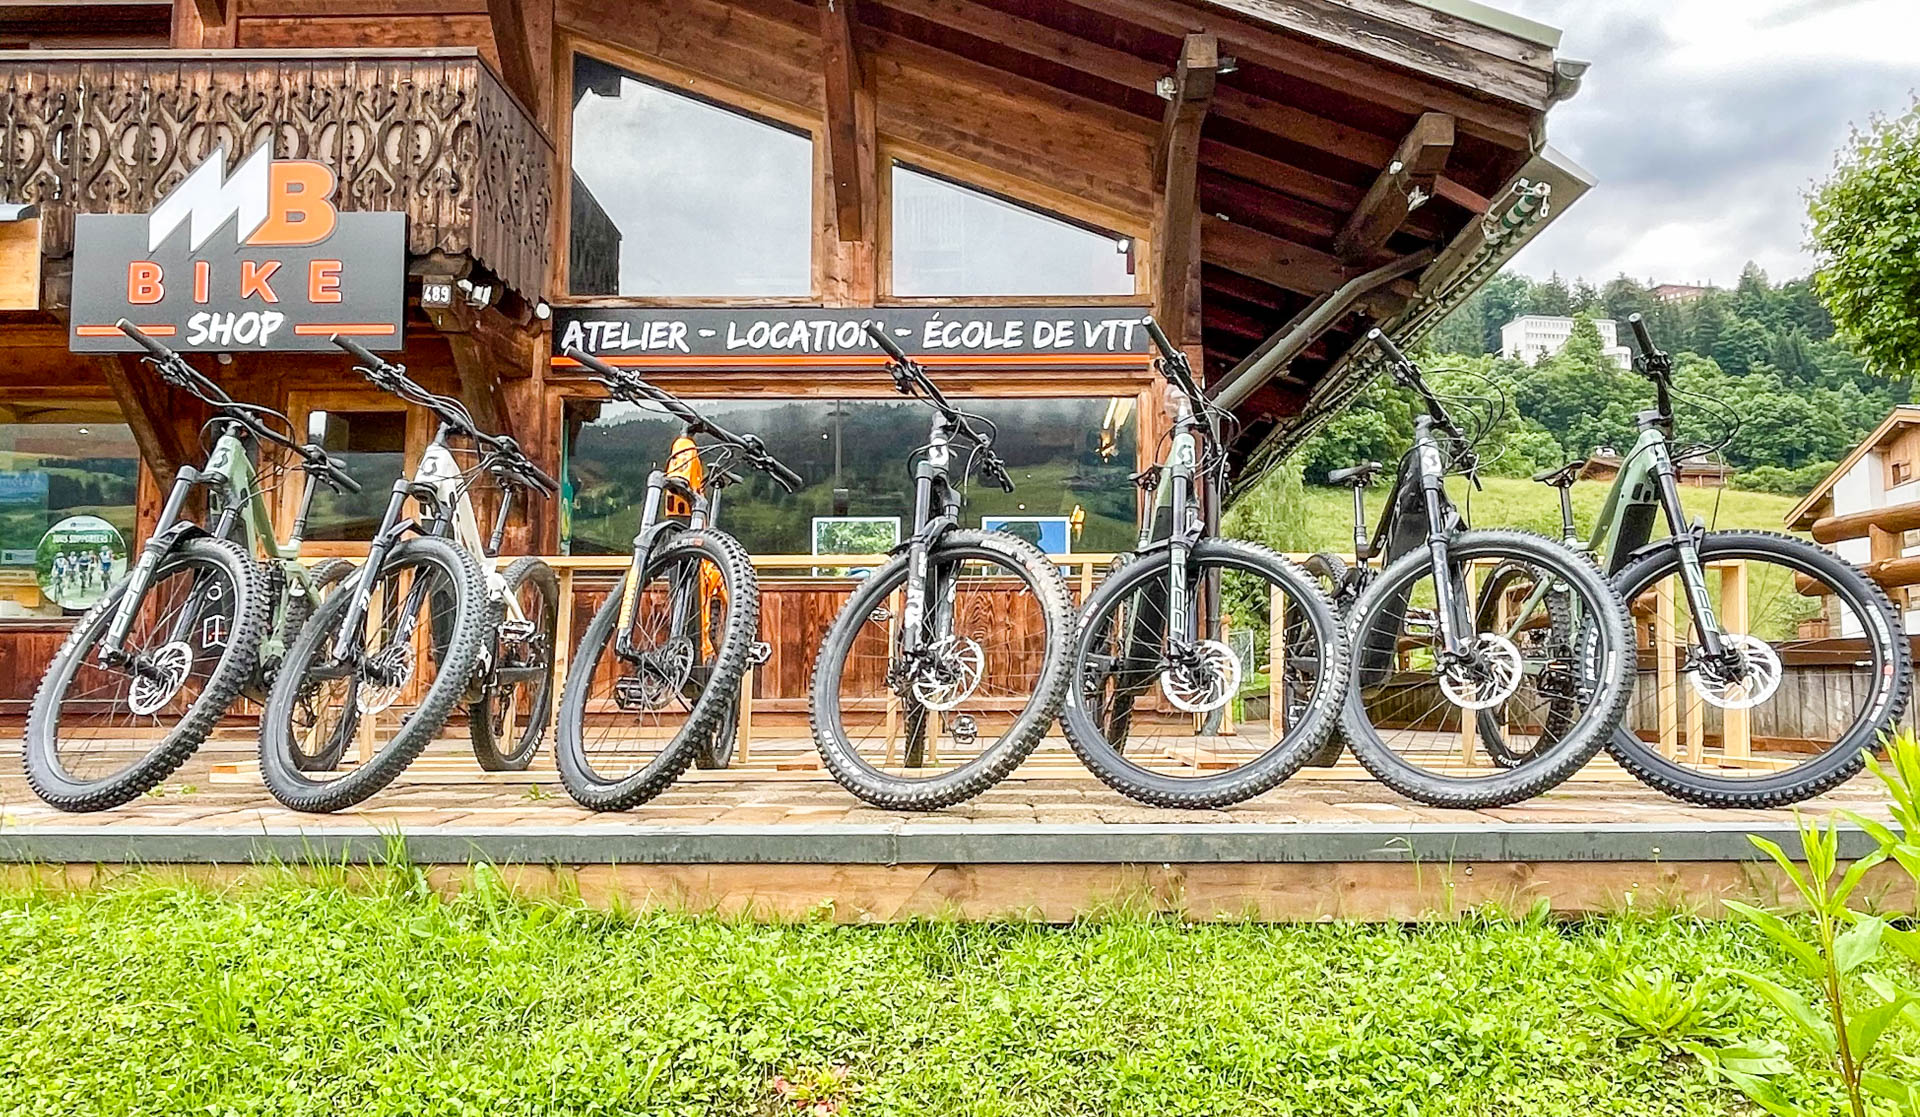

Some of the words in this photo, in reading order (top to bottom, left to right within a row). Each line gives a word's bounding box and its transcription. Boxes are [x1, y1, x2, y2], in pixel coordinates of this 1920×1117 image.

[148, 141, 337, 254] MB
[127, 260, 343, 304] BIKE
[423, 285, 449, 302] 489
[186, 310, 284, 347] SHOP
[561, 320, 690, 355] ATELIER
[922, 311, 1023, 349] ÉCOLE
[1032, 319, 1074, 349] DE
[1083, 319, 1143, 351] VTT
